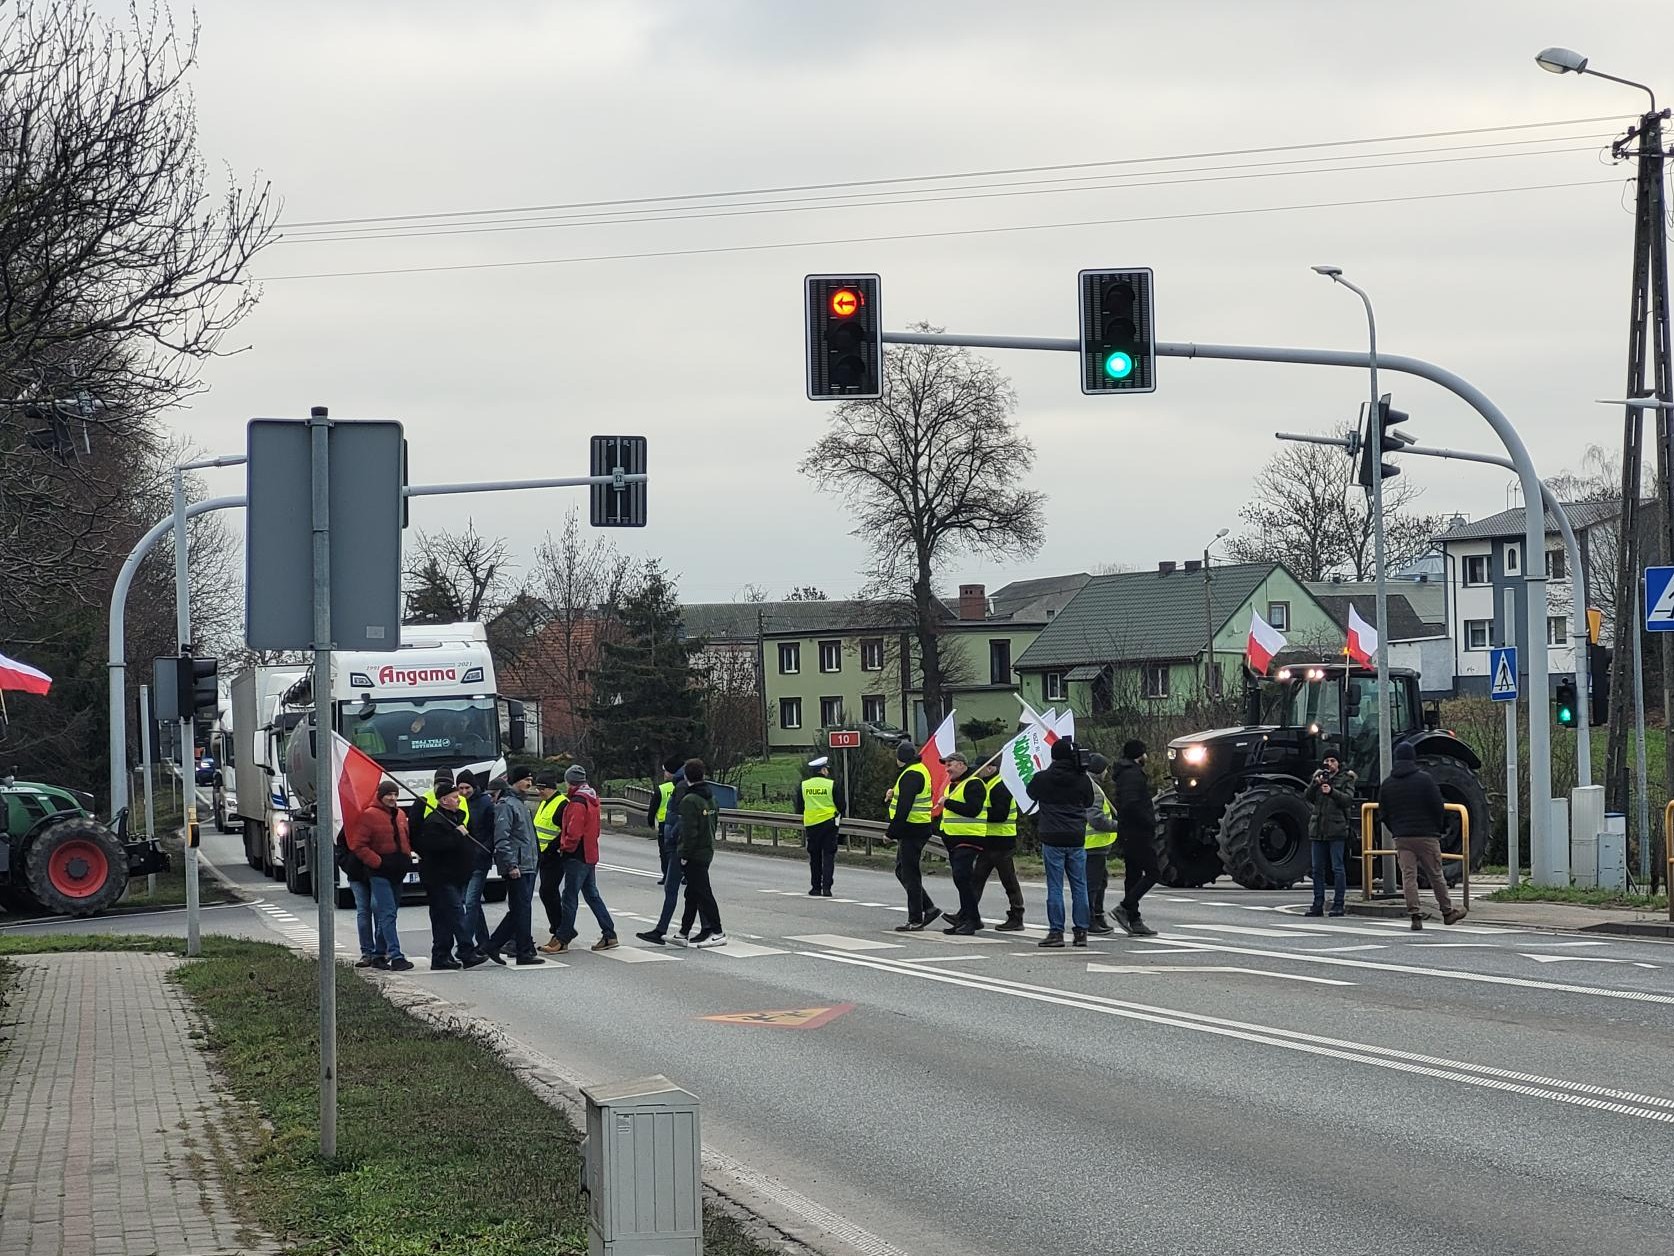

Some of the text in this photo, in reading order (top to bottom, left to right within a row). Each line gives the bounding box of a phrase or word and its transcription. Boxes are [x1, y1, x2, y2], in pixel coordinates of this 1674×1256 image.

[379, 665, 456, 686] Angama
[838, 734, 850, 744] 10
[805, 788, 828, 796] POLICJA
